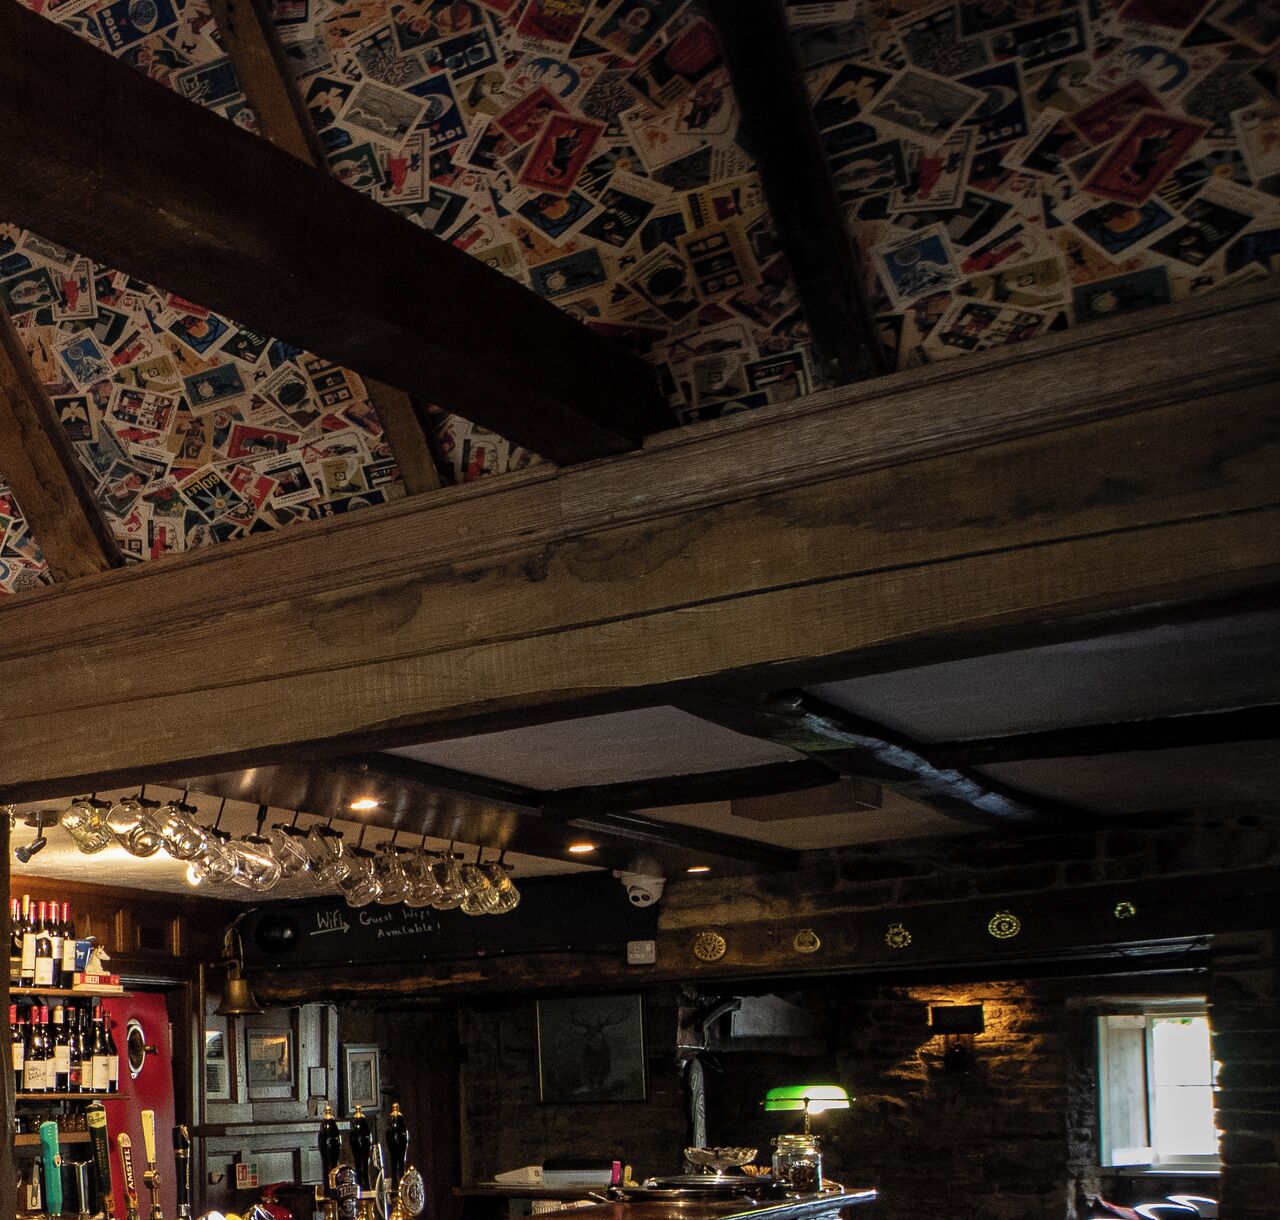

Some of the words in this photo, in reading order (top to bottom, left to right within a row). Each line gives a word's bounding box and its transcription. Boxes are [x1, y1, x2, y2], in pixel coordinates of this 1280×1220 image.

[429, 126, 463, 146] OLDI
[316, 910, 343, 929] Wifi
[359, 911, 393, 925] Guest
[123, 1147, 135, 1190] AMSTEL
